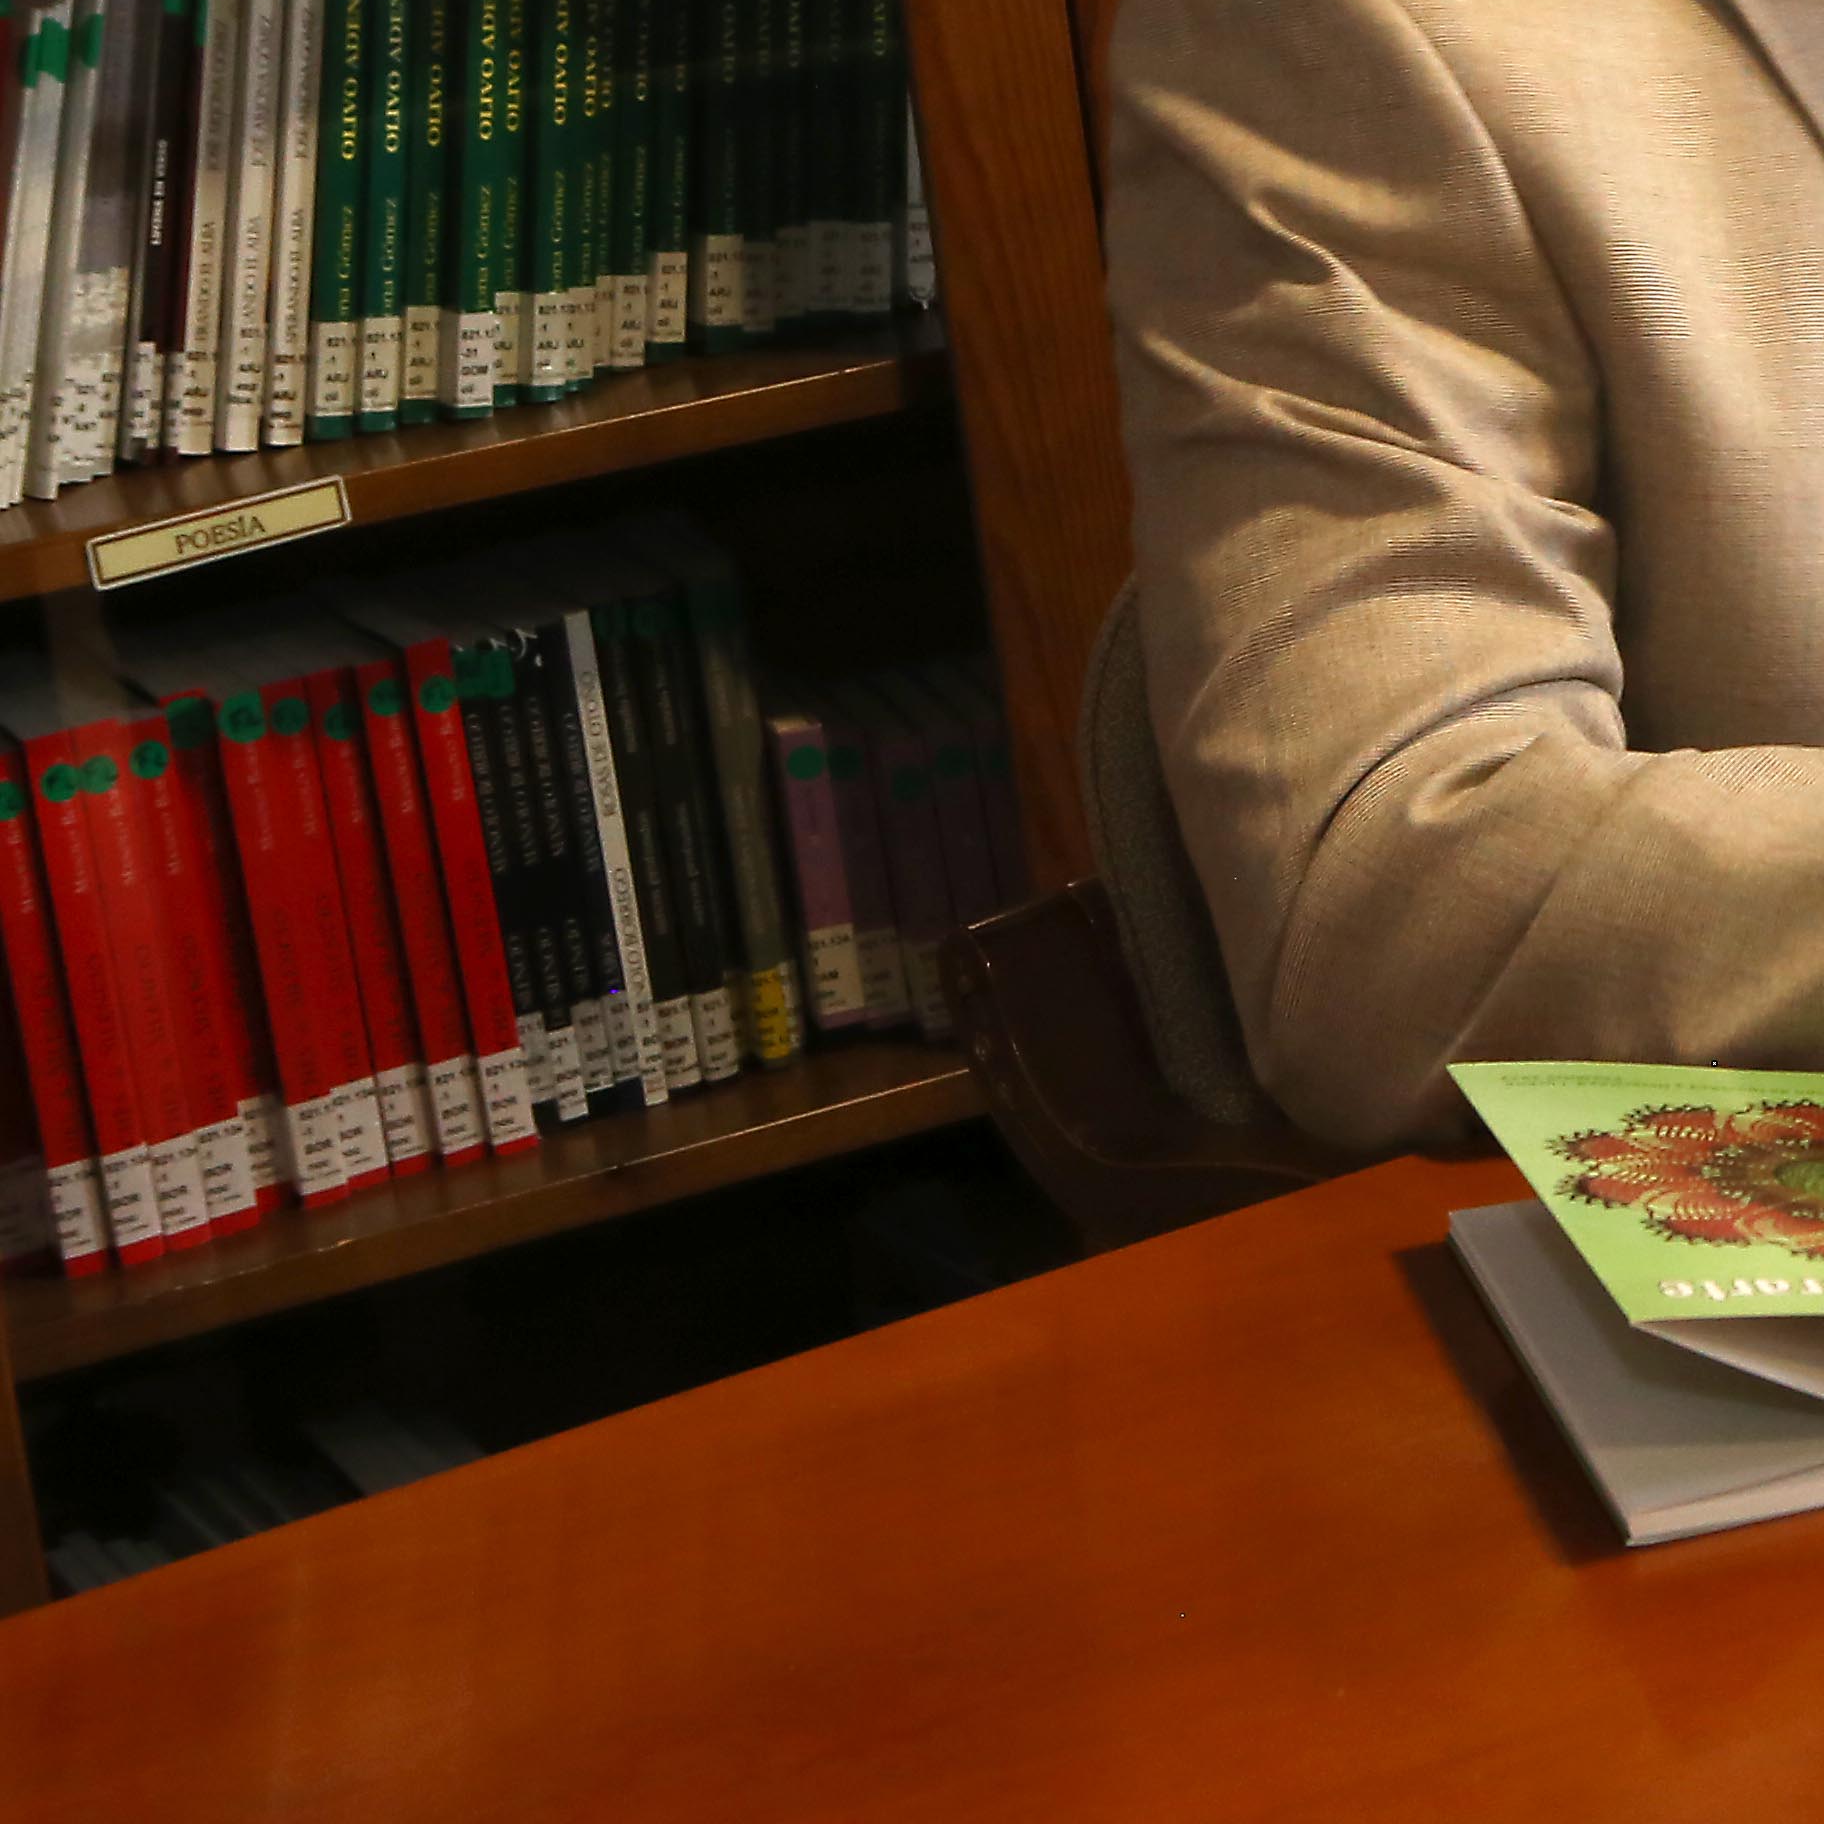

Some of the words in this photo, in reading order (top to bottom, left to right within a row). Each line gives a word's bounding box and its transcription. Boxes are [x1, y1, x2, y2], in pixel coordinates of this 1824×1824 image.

[384, 69, 402, 153] OLIVO
[426, 63, 444, 147] OLIVO
[476, 56, 495, 140] OLIVO
[504, 48, 522, 132] OLIVO
[552, 42, 569, 125] OLIVO
[581, 34, 599, 117] OLIVO
[340, 76, 359, 160] OLIVO
[175, 514, 267, 555] POESÍA
